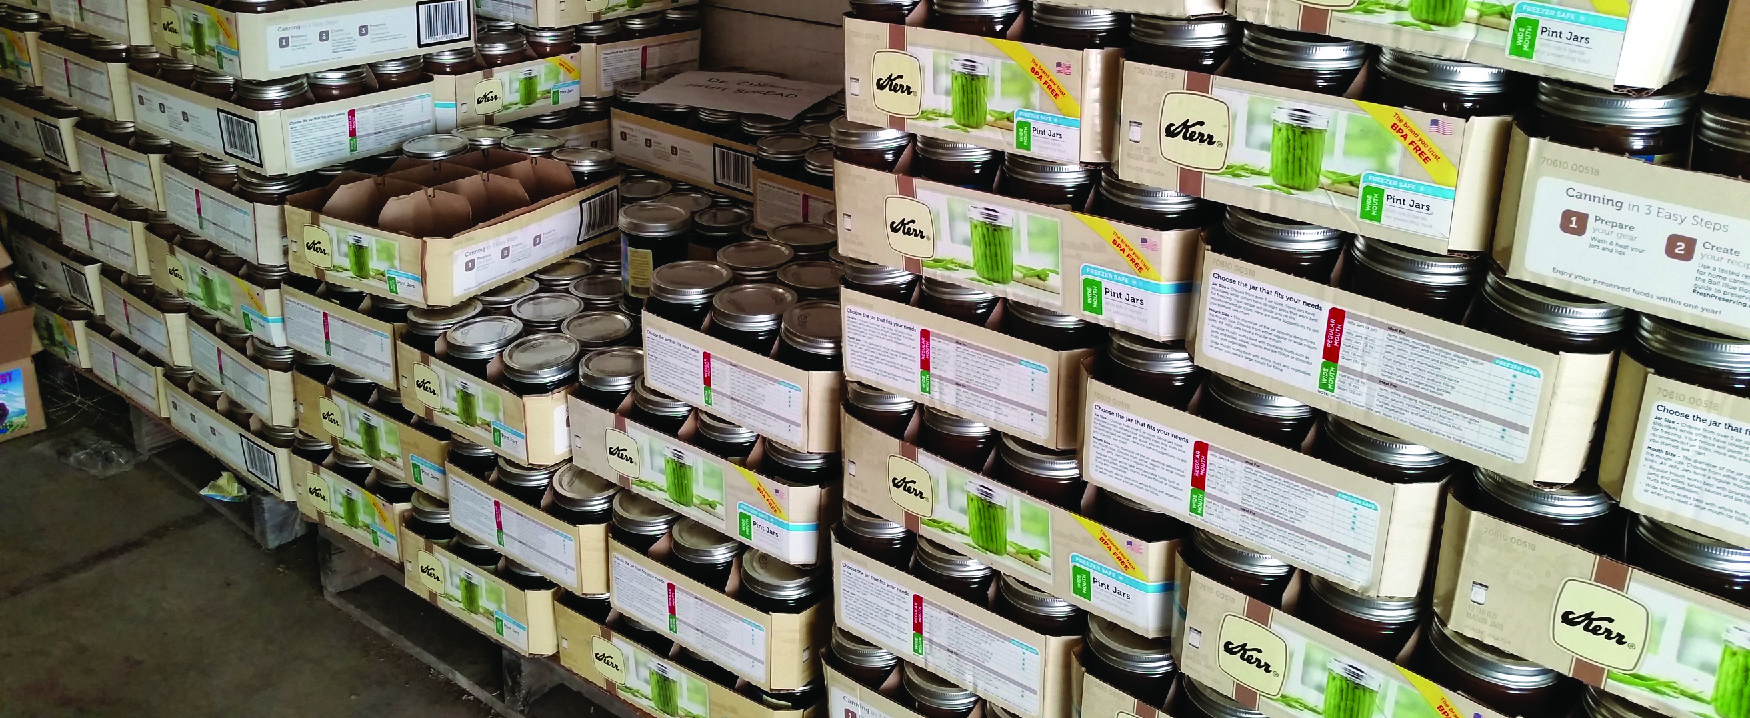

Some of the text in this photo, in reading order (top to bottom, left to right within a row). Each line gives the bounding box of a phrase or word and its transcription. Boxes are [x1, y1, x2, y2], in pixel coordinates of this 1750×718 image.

[1522, 5, 1576, 20] FREEZER SAFE
[1516, 27, 1525, 46] WIDE
[1523, 25, 1533, 51] MOUTH
[1540, 26, 1590, 44] Pint Jars
[1029, 66, 1060, 100] BPA FREE
[733, 88, 798, 99] SPREAD
[1032, 126, 1063, 139] Pint Jars
[1393, 112, 1441, 162] The brand you trust
[1390, 122, 1431, 164] BPA FREE
[1541, 156, 1600, 176] 70610 00518
[1368, 175, 1416, 190] FREEZER SAFE
[1365, 194, 1373, 211] WIDE
[1371, 193, 1380, 216] MOUTH
[1386, 194, 1431, 212] Pint Jars
[1565, 186, 1730, 233] Canning in 3 Easy Steps
[1568, 216, 1578, 229] 1
[1594, 215, 1635, 232] Prepare
[1591, 226, 1638, 242] your gear
[1590, 236, 1608, 246] Wash
[1614, 241, 1630, 251] heat
[1631, 245, 1646, 255] your
[1601, 246, 1614, 254] and
[1674, 242, 1685, 254] 2
[1702, 240, 1741, 257] Create
[1111, 238, 1143, 274] BPA FREE
[1700, 252, 1724, 265] your
[1086, 267, 1129, 284] FREEZER SAFE
[1694, 275, 1705, 284] the
[1696, 268, 1727, 281] for home
[1718, 266, 1739, 277] tested
[1104, 287, 1144, 306] Pint Jars
[1212, 272, 1323, 311] Choose the jar that fits your needs
[1552, 266, 1722, 316] Enjoy your preserved foods within one year!
[1326, 318, 1336, 348] REGULAR
[1333, 324, 1342, 347] MOUTH
[1321, 367, 1329, 385] WIDE
[1327, 366, 1336, 392] MOUTH
[1657, 387, 1720, 410] 70610 00518
[1094, 404, 1189, 444] Choose the jar that fits your needs
[1656, 404, 1743, 434] Choose the jar that
[1510, 536, 1537, 551] 00518
[1099, 536, 1129, 571] BPA FREE
[1092, 576, 1131, 600] Pint Jars
[842, 695, 870, 714] Canning
[1441, 696, 1449, 707] The
